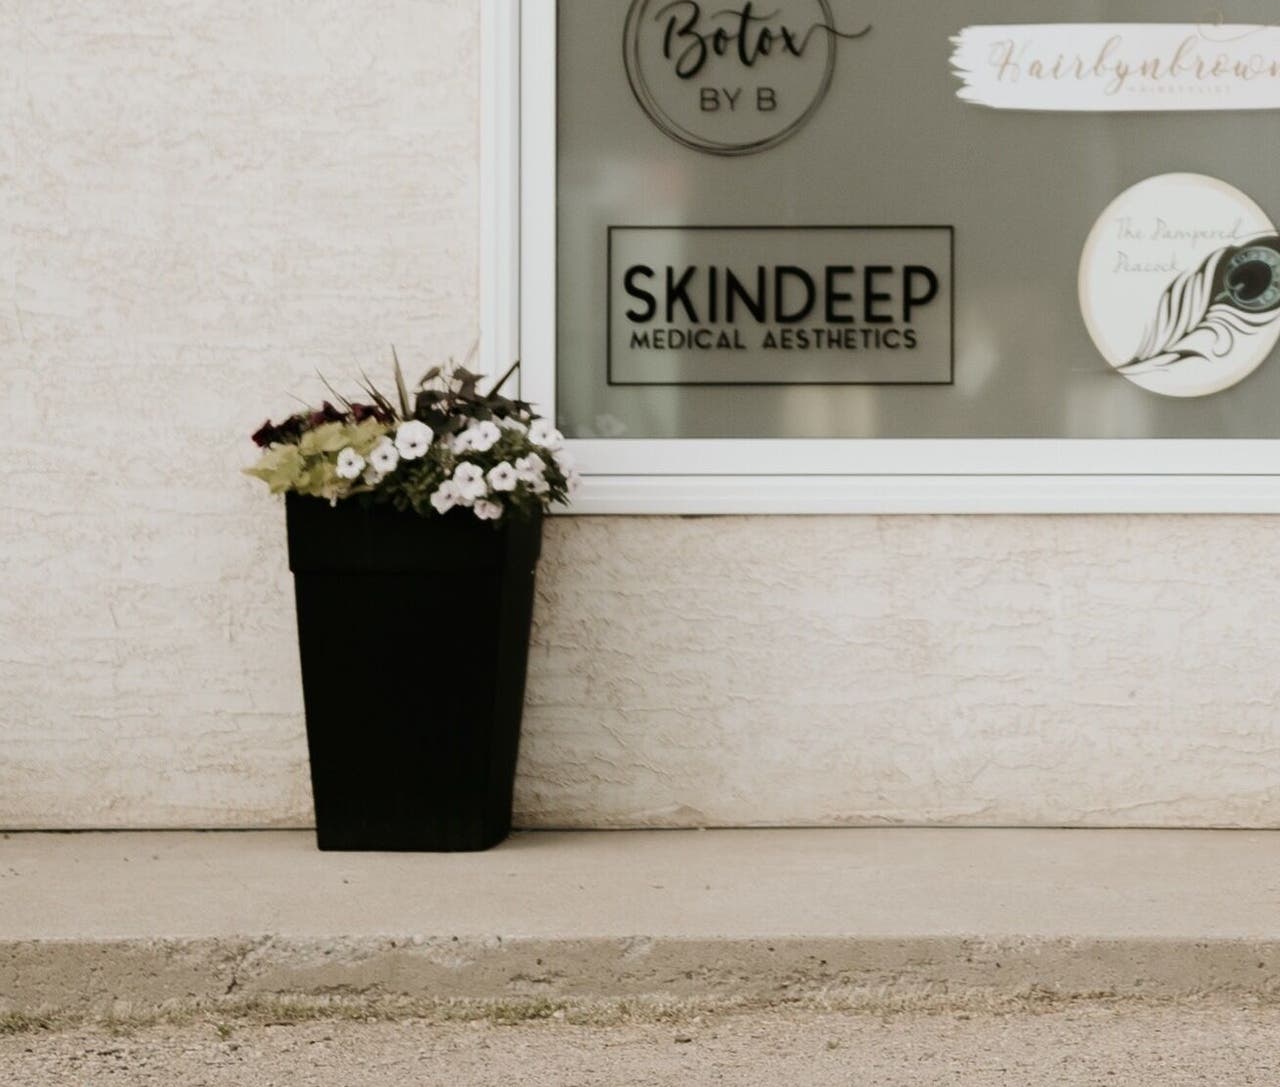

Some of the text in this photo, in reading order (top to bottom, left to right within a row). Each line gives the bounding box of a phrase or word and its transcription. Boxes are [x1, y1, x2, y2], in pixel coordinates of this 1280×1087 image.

[655, 0, 872, 80] Botox
[700, 88, 777, 112] BY B
[623, 264, 939, 323] SKINDEEP
[630, 328, 918, 349] MEDICAL AESTHETICS
